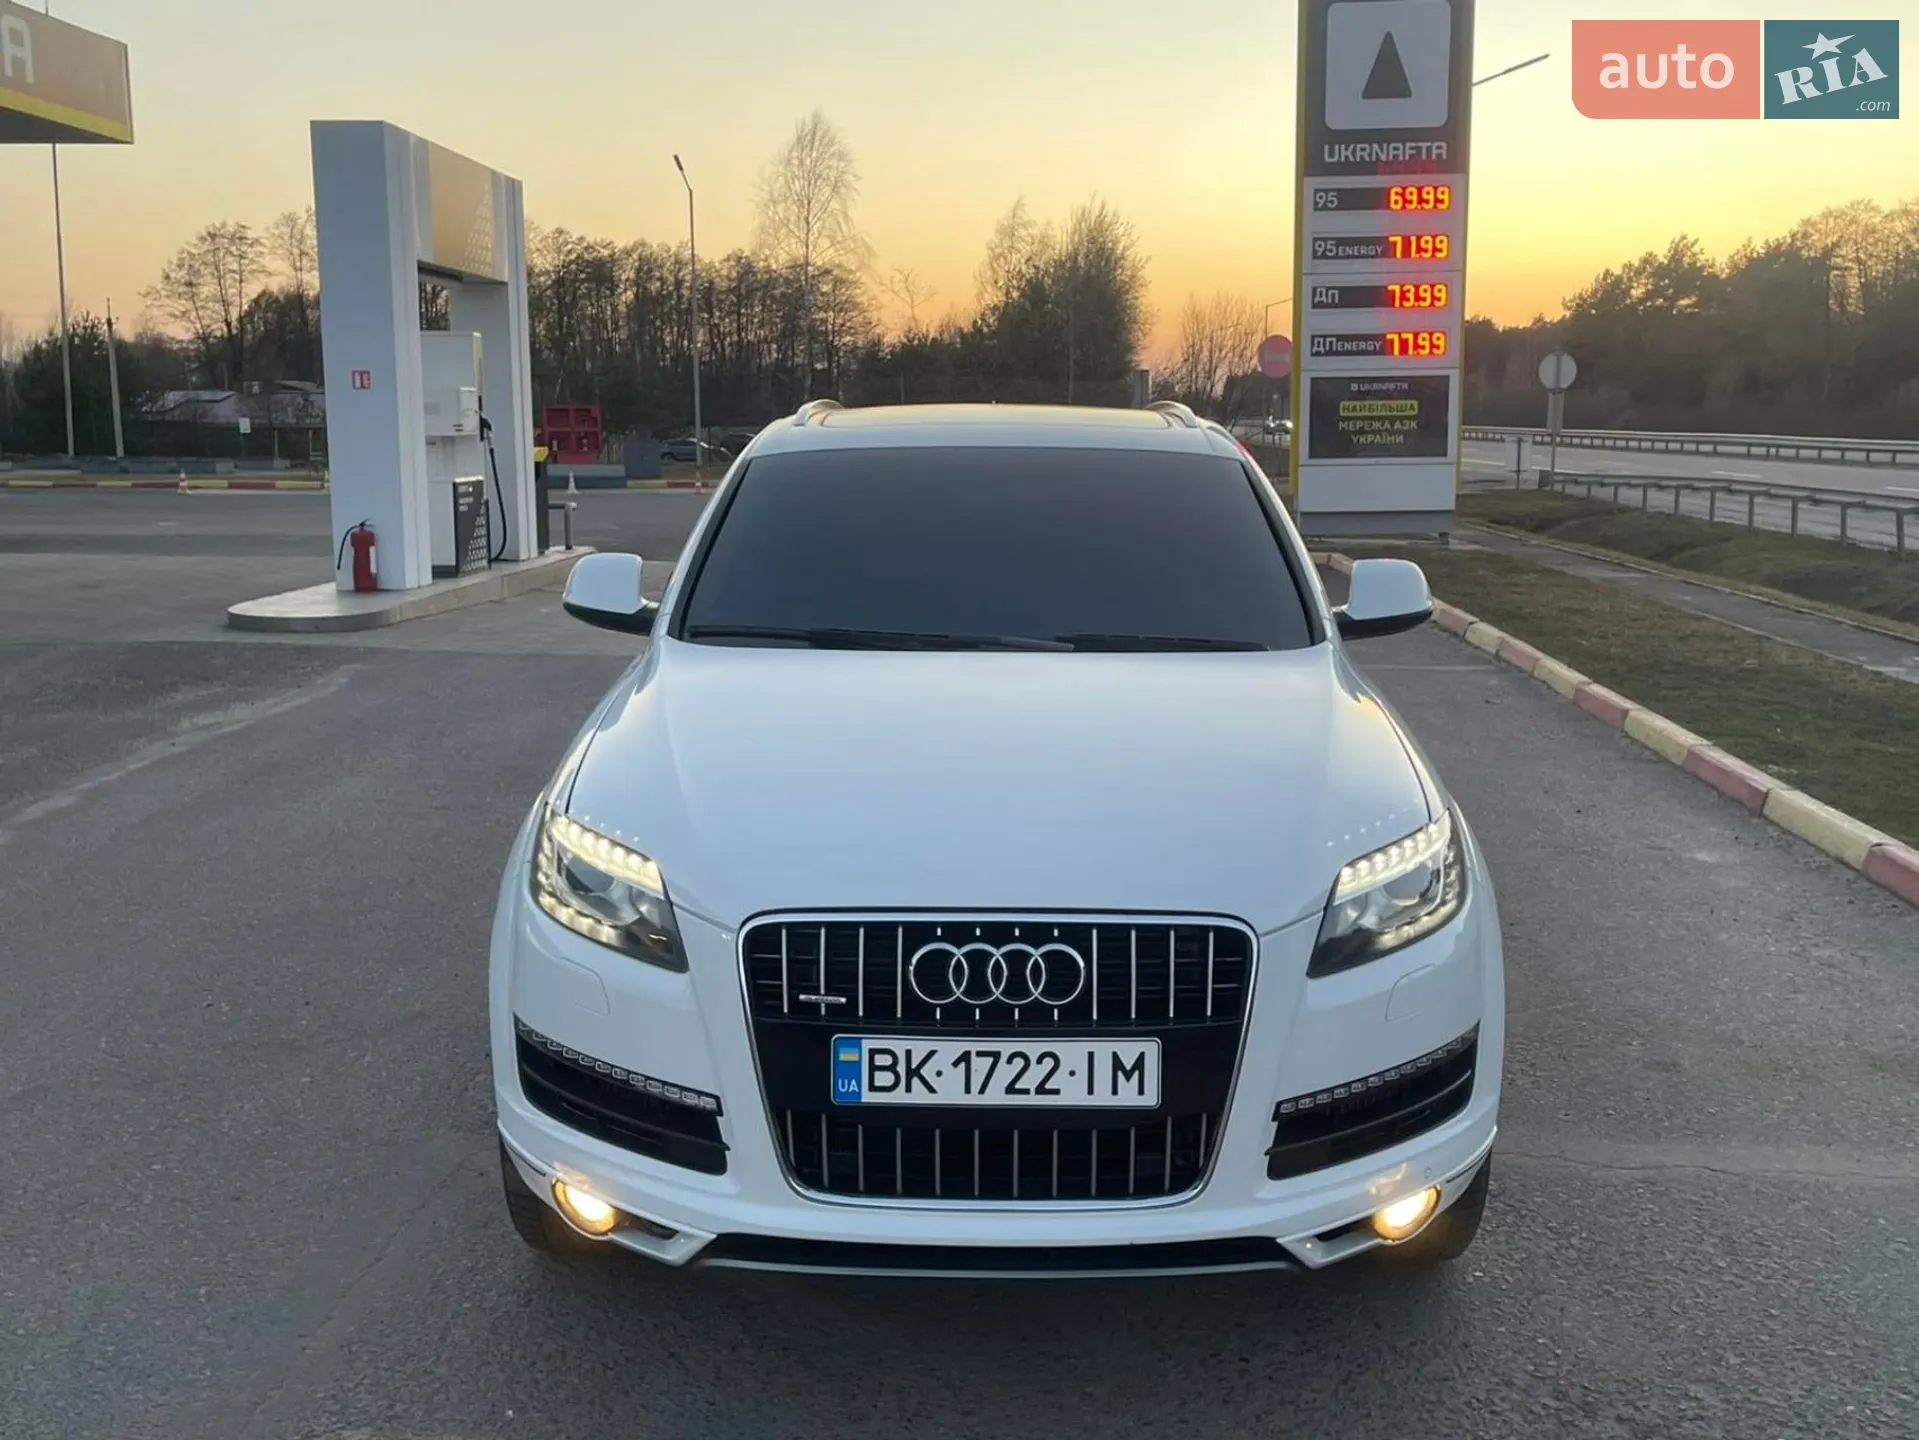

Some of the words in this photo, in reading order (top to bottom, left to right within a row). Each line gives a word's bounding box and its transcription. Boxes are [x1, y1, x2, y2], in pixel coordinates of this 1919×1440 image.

[1324, 142, 1447, 162] UKRNAFTA
[1315, 192, 1338, 208] 95
[1389, 186, 1449, 210] 69.99
[1388, 235, 1448, 259] 71.99
[1387, 284, 1447, 308] 73.99
[1386, 332, 1446, 356] 77.99
[1342, 402, 1416, 414] НАЙБІЛЬША
[1339, 420, 1392, 431] МЕРЕЖА
[1394, 419, 1418, 430] АЗК
[1350, 432, 1405, 445] УКРАЇНИ
[838, 1079, 859, 1093] UA
